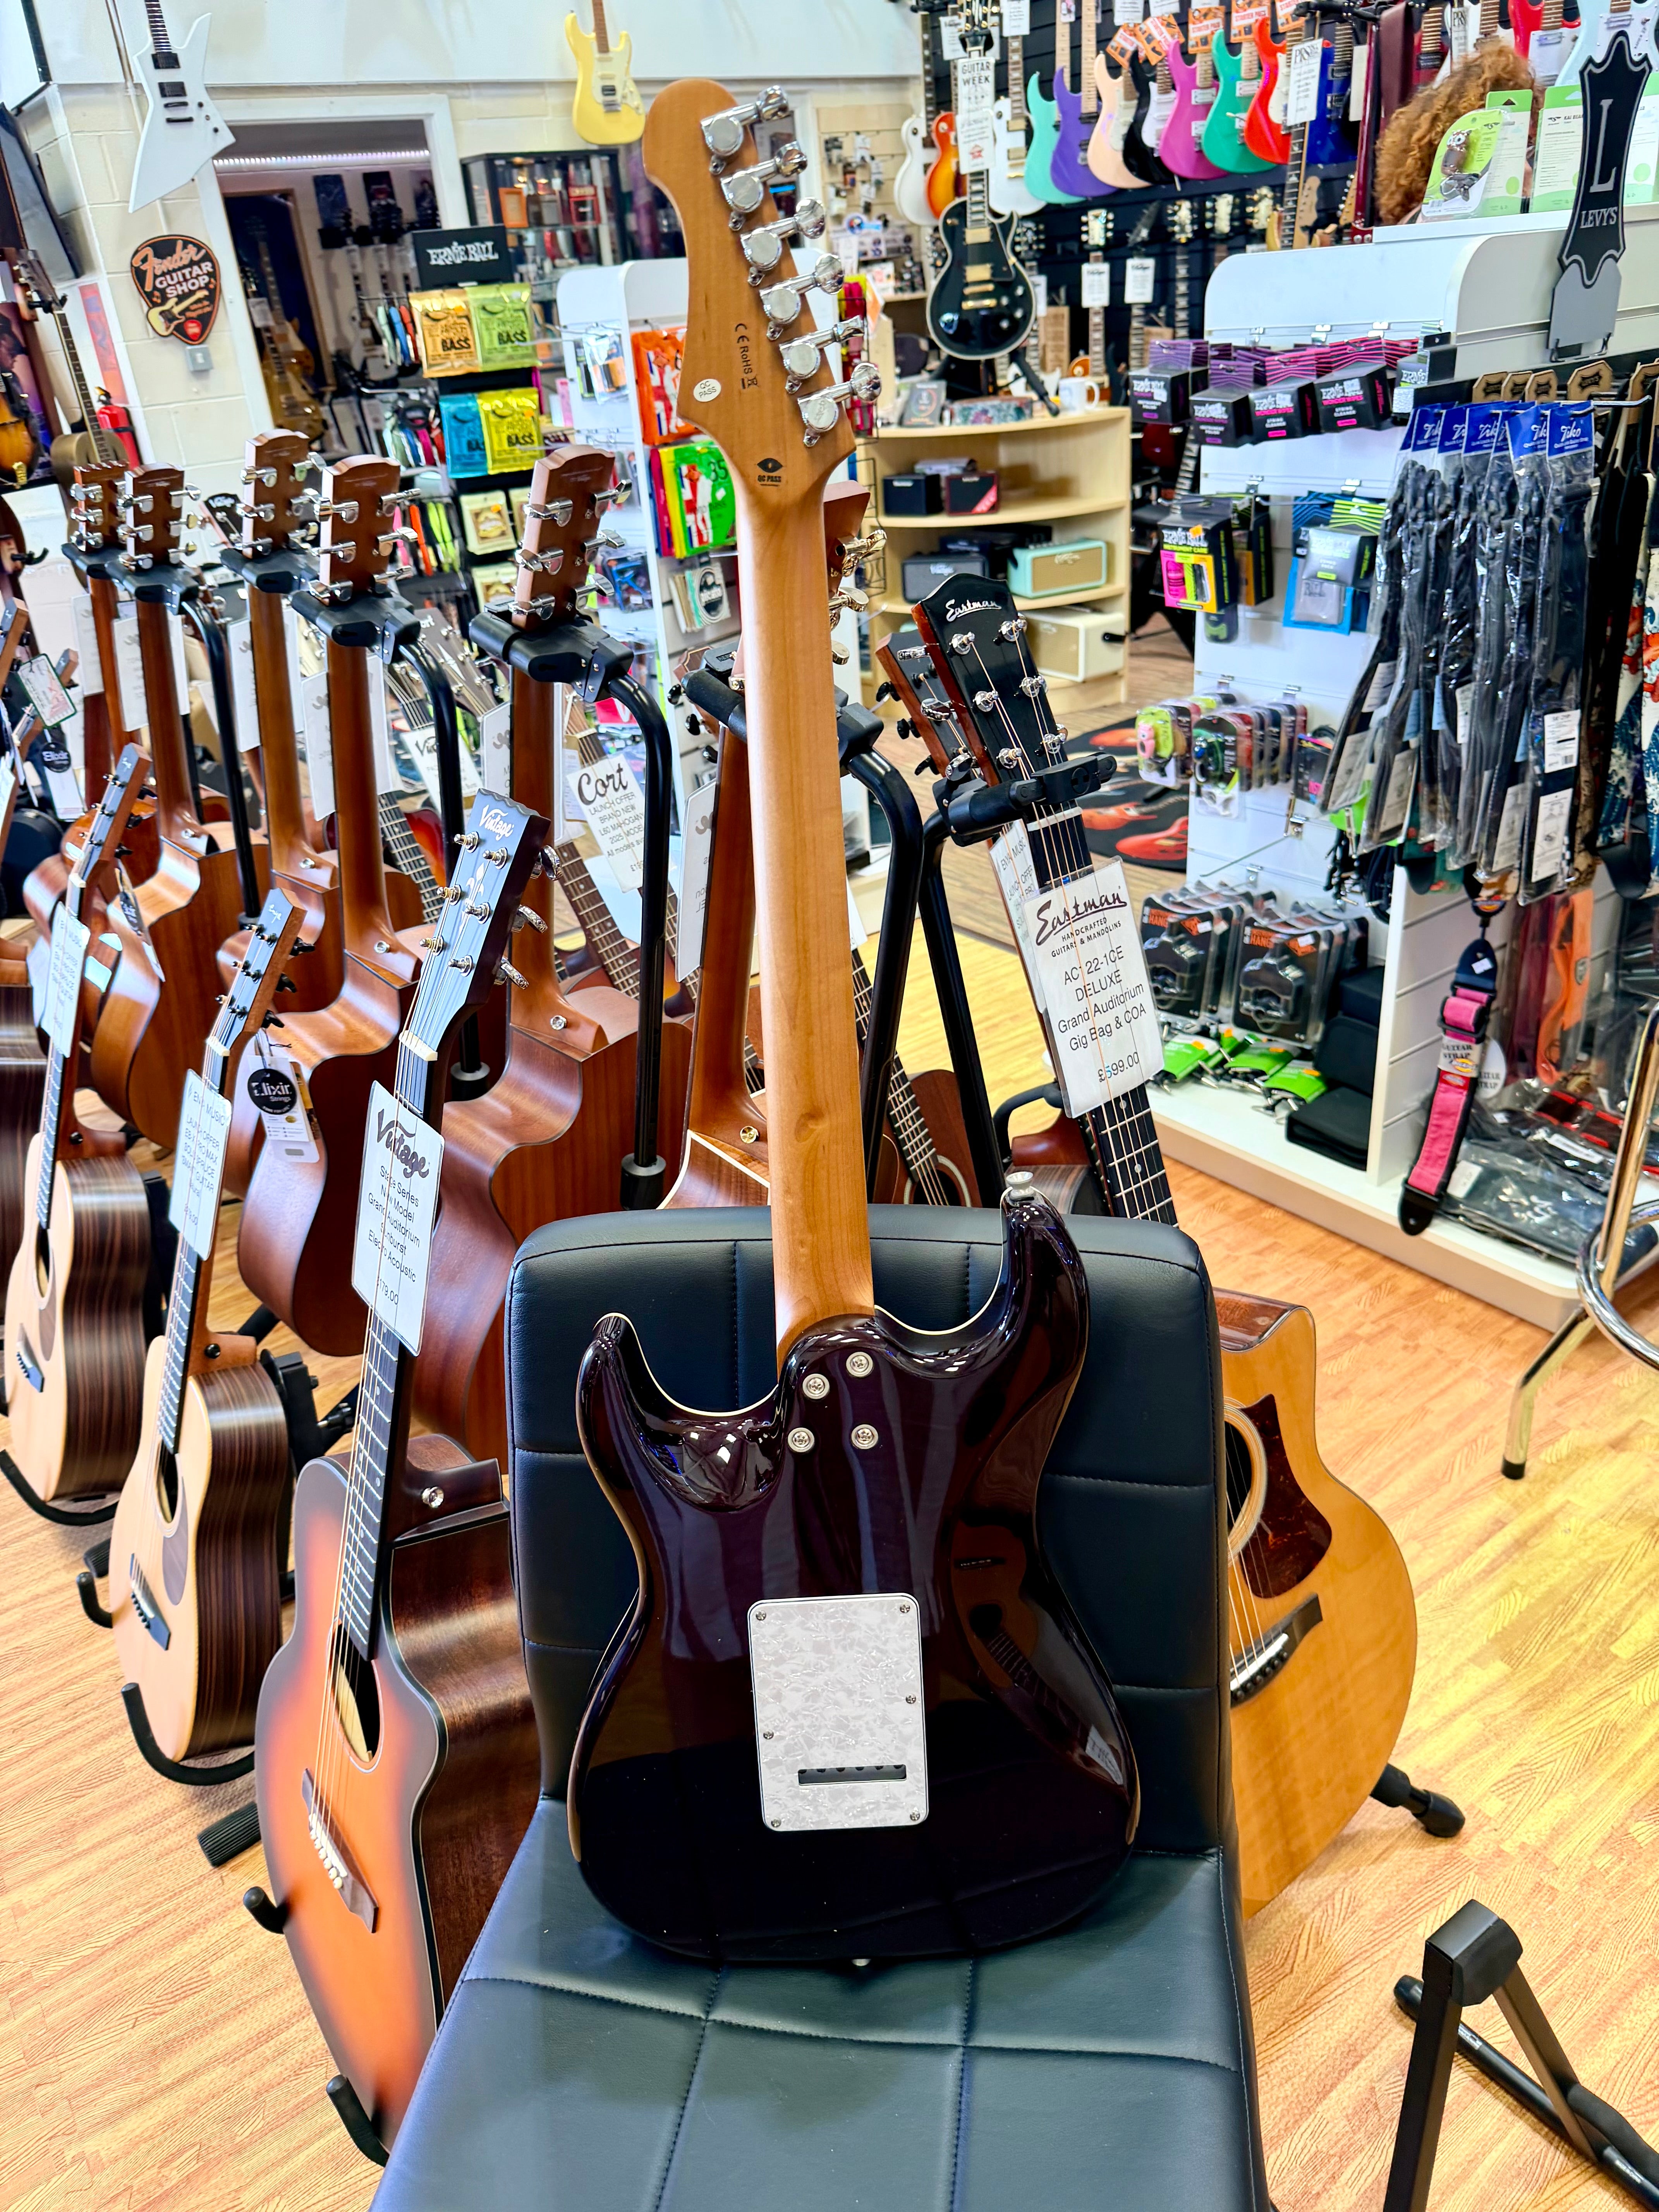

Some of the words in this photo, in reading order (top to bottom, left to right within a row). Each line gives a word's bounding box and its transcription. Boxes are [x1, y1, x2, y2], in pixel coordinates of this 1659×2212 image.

[962, 61, 991, 75] GUITAR
[962, 75, 991, 86] WEEK
[1580, 206, 1618, 228] LEVY'S
[426, 241, 467, 265] ERNIE
[466, 241, 499, 262] BALL
[132, 240, 206, 291] Fender
[155, 261, 214, 289] GUITAR
[165, 275, 210, 298] SHOP
[441, 337, 471, 351] BASS
[498, 330, 527, 345] BASS
[739, 345, 753, 374] RoHS
[699, 386, 717, 398] PASS
[700, 380, 711, 389] QC
[507, 433, 535, 447] BASS
[707, 459, 728, 482] 35
[945, 599, 1002, 622] Eastman
[577, 763, 628, 806] Cort
[615, 792, 636, 805] OFFER
[479, 804, 515, 841] Vintage
[599, 810, 622, 824] BRAND
[622, 803, 636, 814] NEW
[610, 833, 624, 845] 2025
[624, 824, 644, 837] MODE
[1012, 836, 1026, 859] MUSIC
[1020, 865, 1033, 884] OFFER
[1036, 892, 1127, 946] Eastman
[1061, 917, 1107, 942] HANDCRAFTED
[1051, 941, 1077, 957] GUITARS
[1086, 920, 1121, 943] MANDOLINS
[1064, 945, 1124, 986] AC22-1CE
[1075, 969, 1122, 1002] DELUXE
[1058, 1007, 1090, 1034] Grand
[1093, 983, 1144, 1017] Auditorium
[1069, 1034, 1089, 1051] Gig
[1089, 1022, 1113, 1041] Bag
[1115, 1016, 1123, 1030] &
[1124, 1003, 1147, 1024] COA
[1097, 1051, 1140, 1083] £599.00
[251, 1082, 292, 1096] Elixir
[206, 1104, 225, 1126] MUSIC
[377, 1108, 429, 1178] Vintage
[397, 1182, 419, 1207] Series
[393, 1198, 415, 1223] Model
[387, 1211, 420, 1248] Auditorium
[387, 1251, 416, 1283] Acoustic
